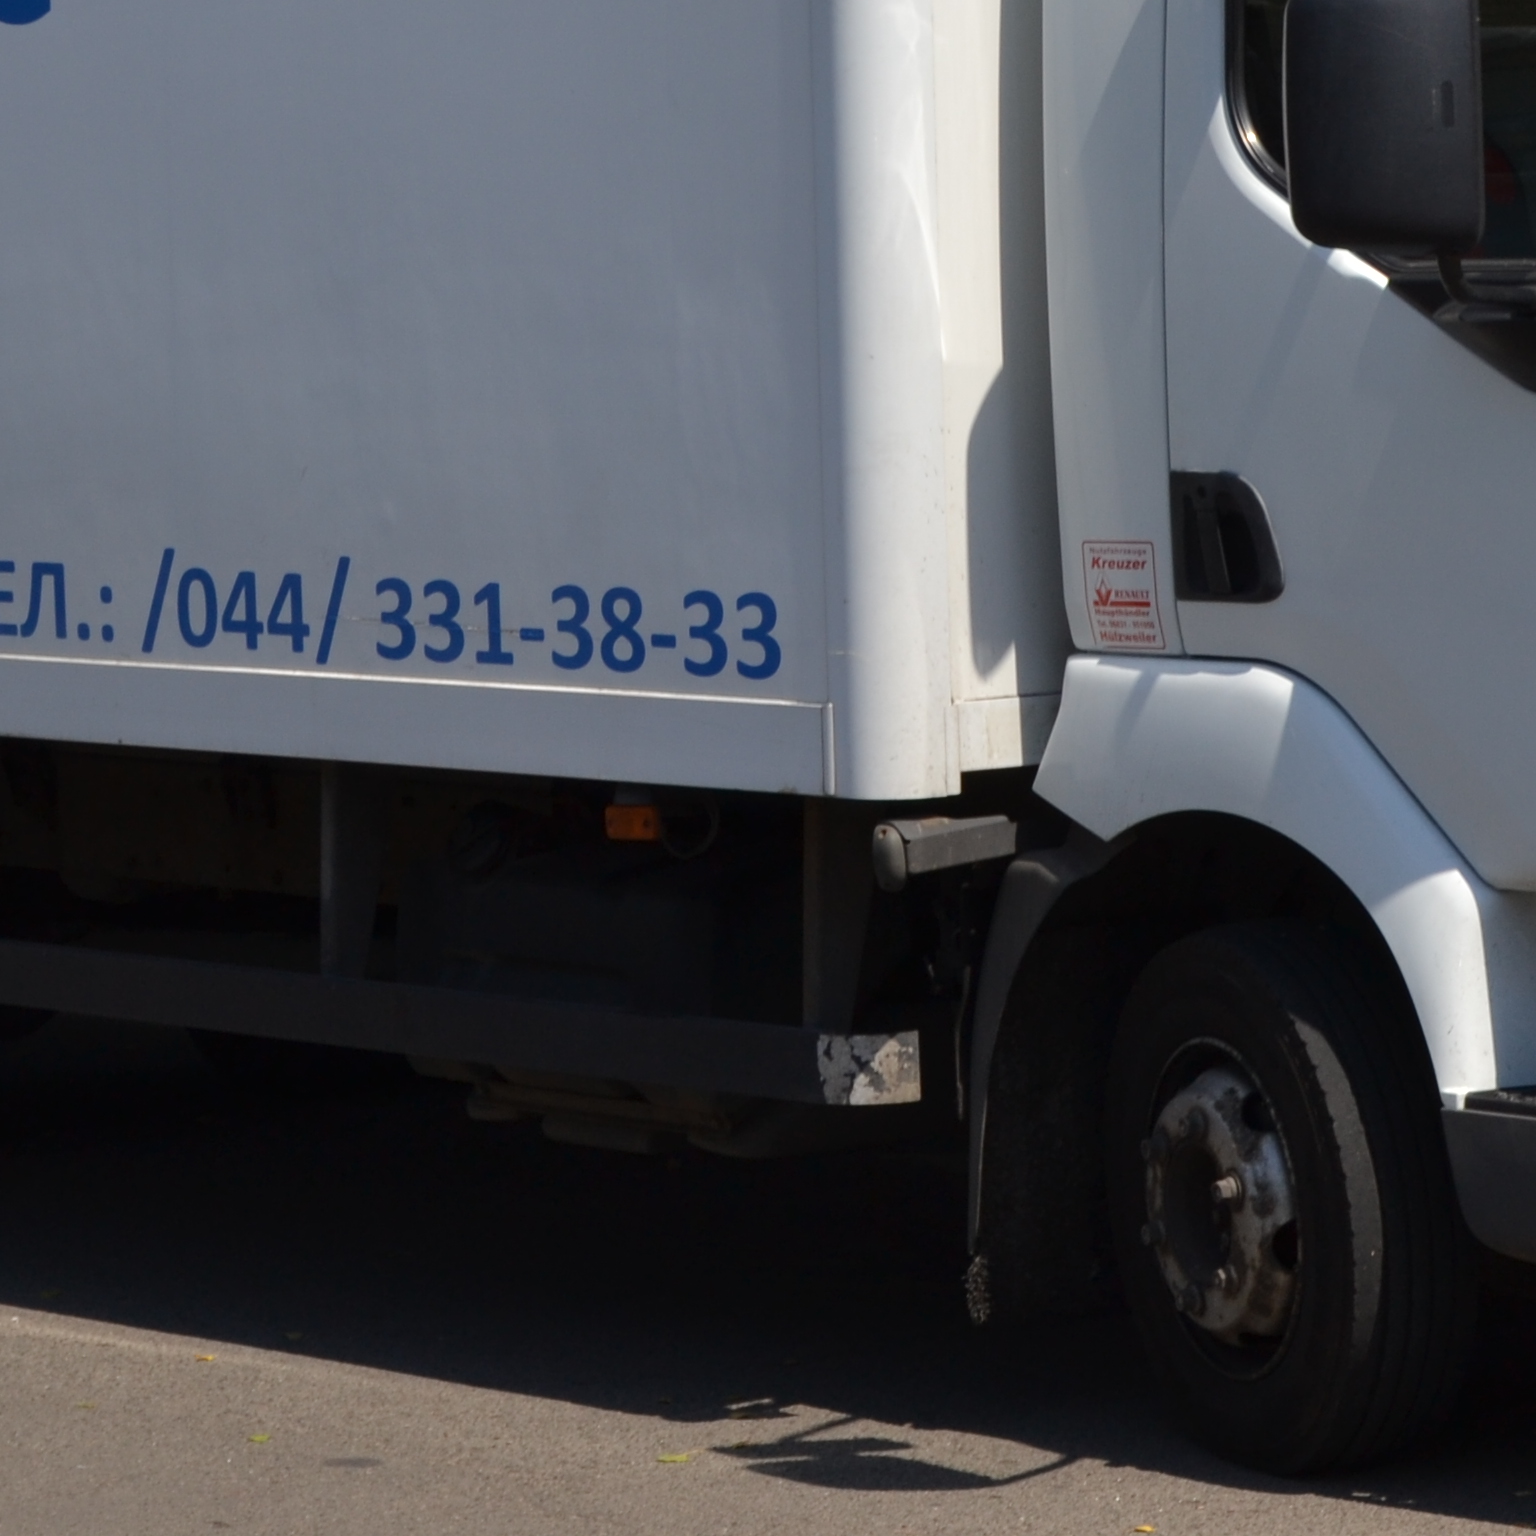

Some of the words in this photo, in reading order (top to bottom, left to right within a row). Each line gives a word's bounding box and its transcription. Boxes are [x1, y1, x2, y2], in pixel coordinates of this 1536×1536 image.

[1091, 557, 1148, 570] Kreuzer
[1114, 589, 1150, 599] RENAULT
[141, 547, 352, 666] /044/
[375, 576, 782, 681] 331-38-33
